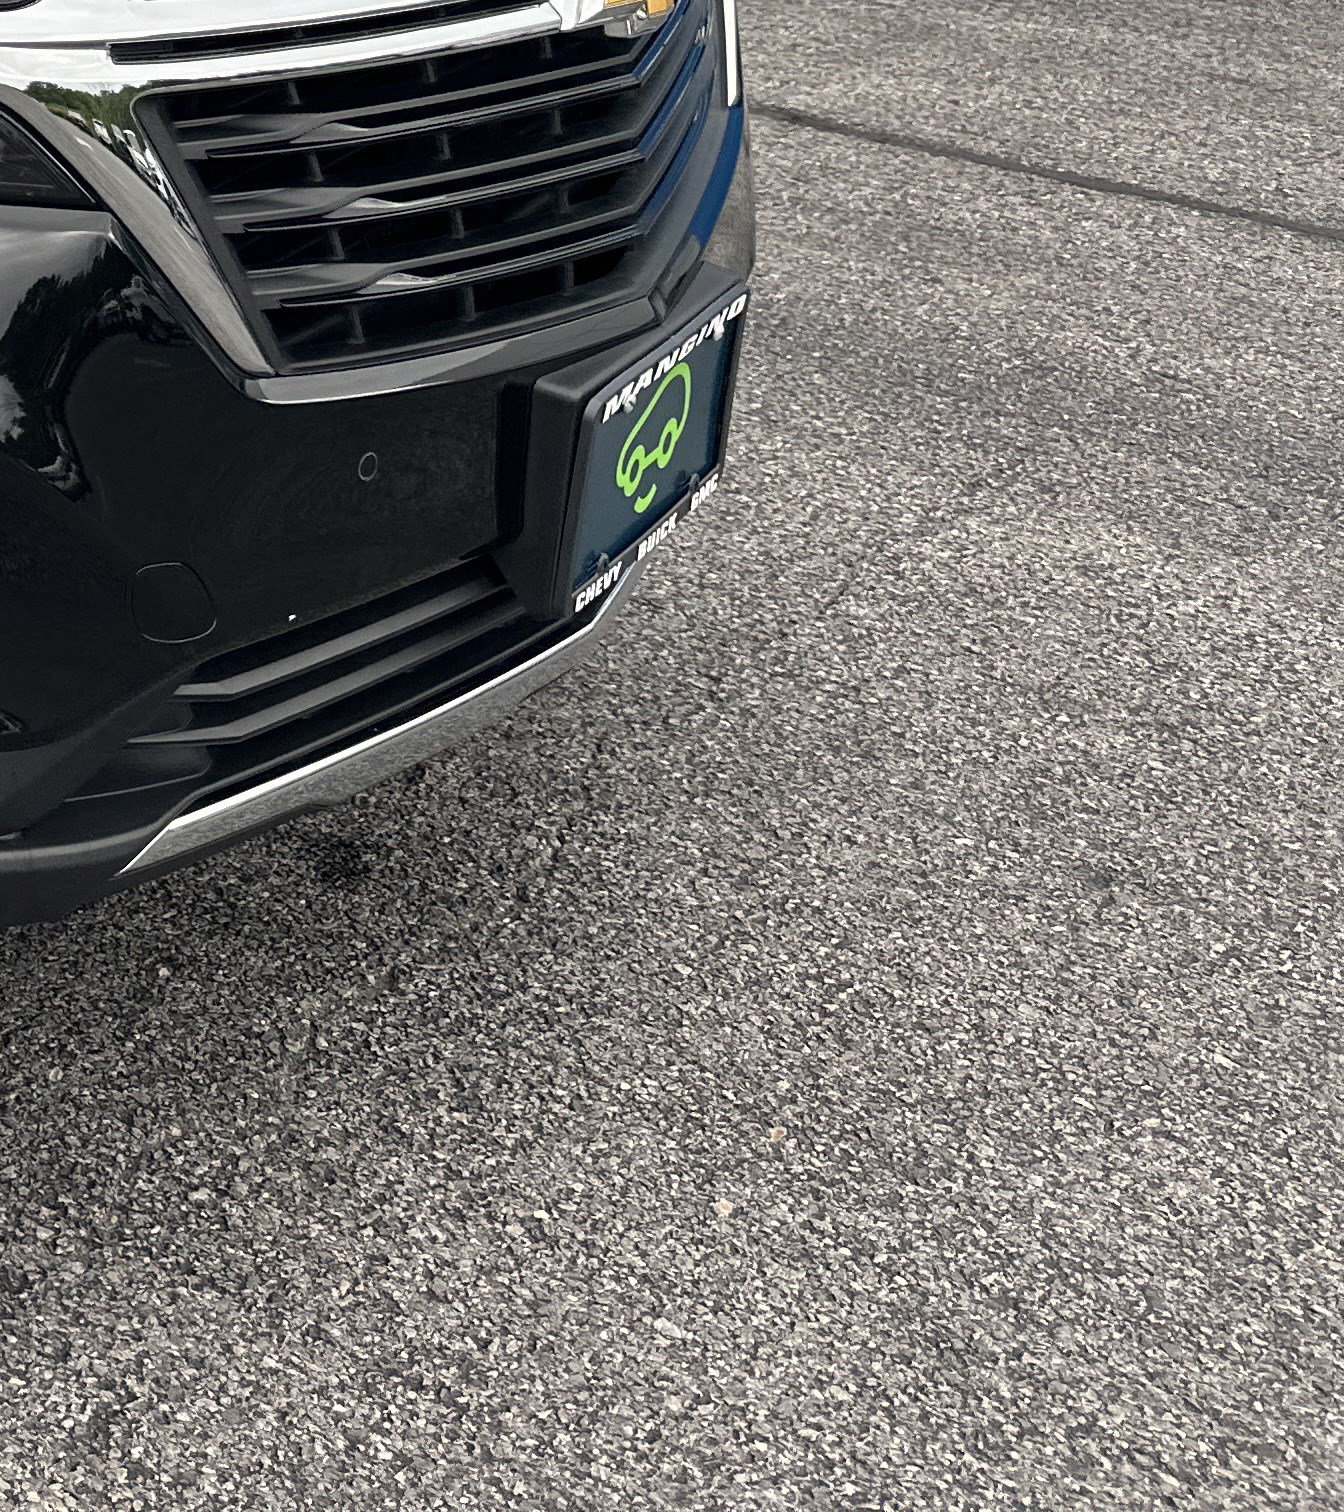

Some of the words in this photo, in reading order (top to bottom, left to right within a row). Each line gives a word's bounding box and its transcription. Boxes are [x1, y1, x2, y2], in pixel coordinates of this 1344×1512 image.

[602, 293, 747, 424] MANGINO
[574, 561, 623, 613] CHEVY
[637, 512, 677, 561] BUICK
[690, 473, 719, 512] GMC
